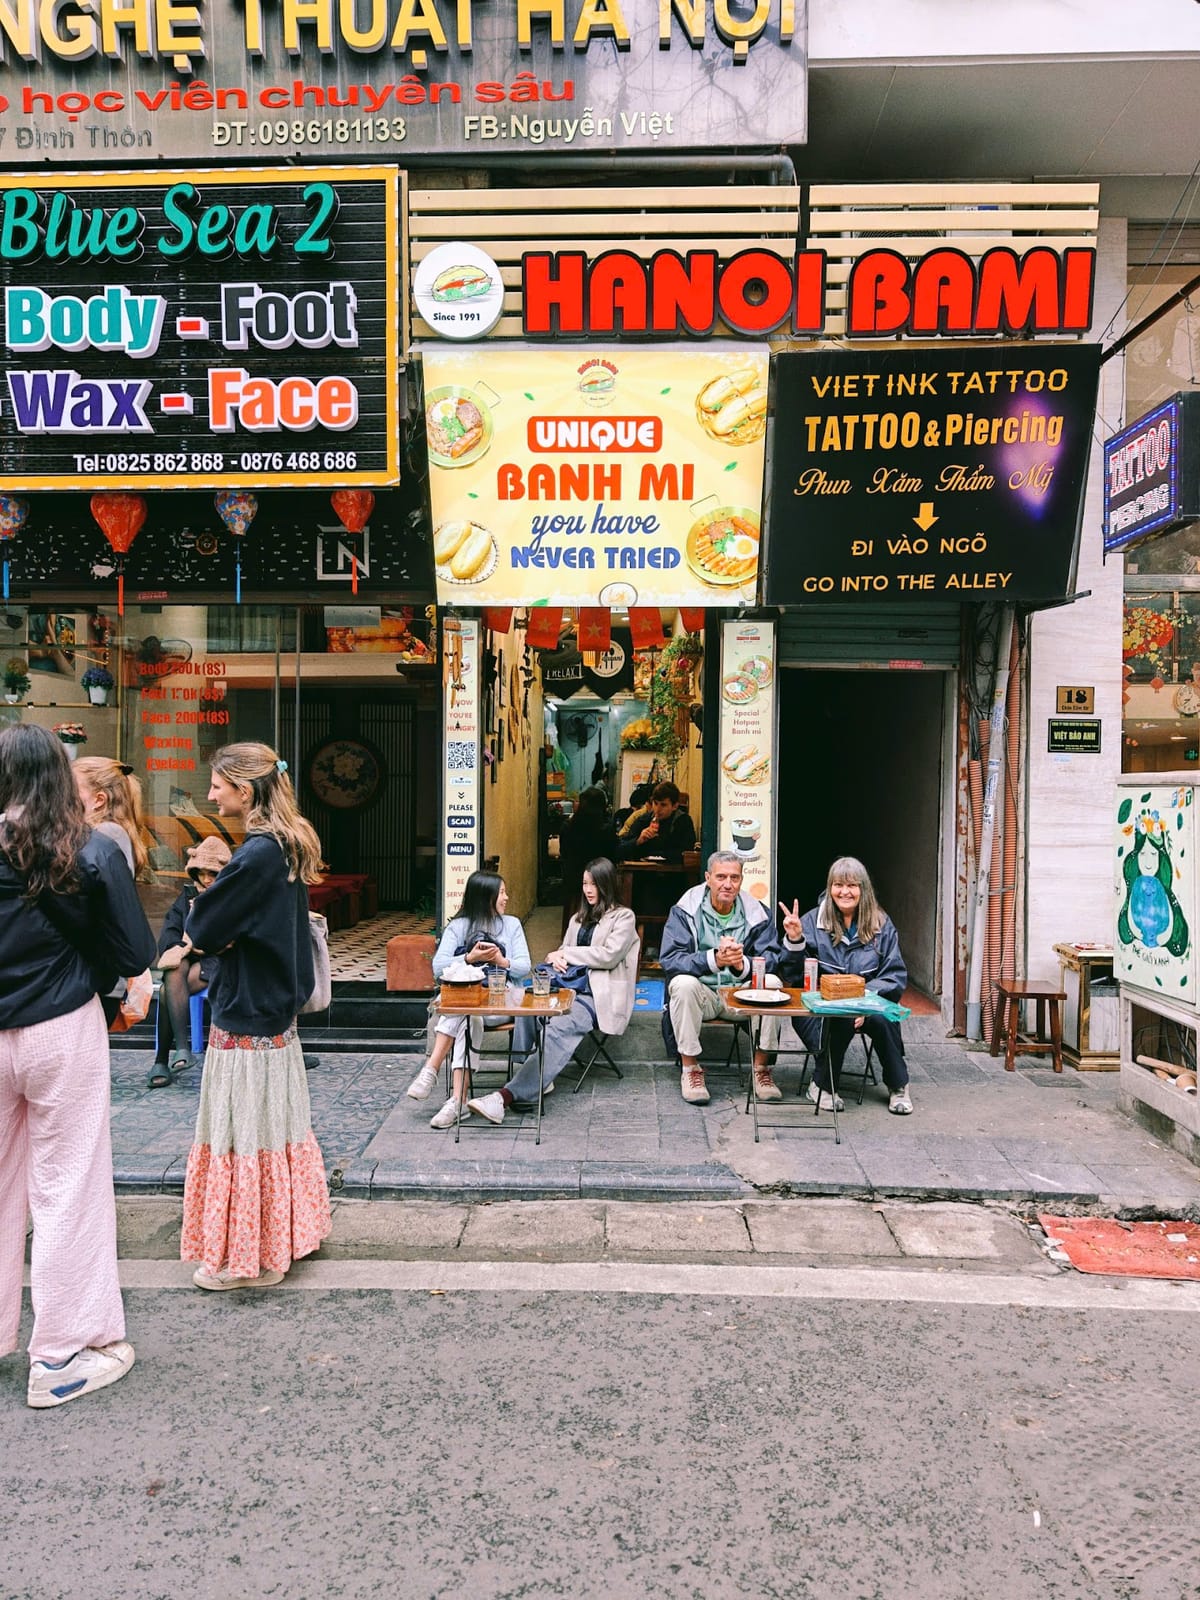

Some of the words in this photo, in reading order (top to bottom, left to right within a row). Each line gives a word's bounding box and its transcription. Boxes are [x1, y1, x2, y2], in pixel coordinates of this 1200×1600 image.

[22, 86, 125, 122] học
[135, 80, 248, 111] viên
[259, 75, 462, 112] chuyên
[474, 71, 575, 105] sâu
[211, 117, 407, 146] ĐT:0986181133
[464, 107, 612, 144] FB:Nguyễn
[620, 112, 674, 140] Việt
[1, 187, 141, 260] Blue
[157, 182, 278, 257] Sea
[293, 182, 337, 255] 2
[523, 249, 827, 337] HANOI
[848, 247, 1096, 336] BAMI
[7, 286, 162, 354] Body
[223, 284, 355, 345] Foot
[433, 312, 456, 321] Since
[459, 312, 481, 321] 1991
[811, 374, 880, 398] VIET
[886, 373, 938, 396] INK
[947, 368, 1069, 396] TATTOO
[8, 371, 148, 430] Wax
[209, 370, 356, 429] Face
[535, 420, 655, 452] UNIQUE
[804, 411, 920, 452] TATTOO
[944, 411, 1064, 447] Piercing
[153, 453, 188, 472] 862
[190, 454, 224, 472] 868
[286, 452, 321, 470] 468
[323, 452, 357, 470] 686
[1109, 420, 1170, 497] TATTOO
[497, 463, 622, 501] BANH
[638, 463, 695, 501] MI
[793, 468, 852, 496] Phun
[866, 467, 923, 494] Xăm
[1008, 461, 1054, 496] Mỹ
[1109, 484, 1170, 534] PIERCING
[531, 513, 586, 557] you
[589, 503, 660, 535] have
[851, 540, 873, 556] ĐI
[886, 534, 929, 555] VÀO
[940, 533, 987, 553] NGÕ
[511, 546, 595, 569] NEVER
[604, 546, 681, 569] TRIED
[803, 576, 834, 593] GO
[841, 575, 889, 592] INTO
[896, 573, 935, 590] THE
[945, 572, 1012, 589] ALLEY
[1065, 689, 1088, 704] 18
[734, 709, 760, 719] Special
[728, 799, 763, 807] Sandwich
[734, 790, 758, 798] Vegan
[451, 818, 472, 826] SCAN
[449, 845, 472, 853] MENU
[743, 867, 766, 875] Coffee
